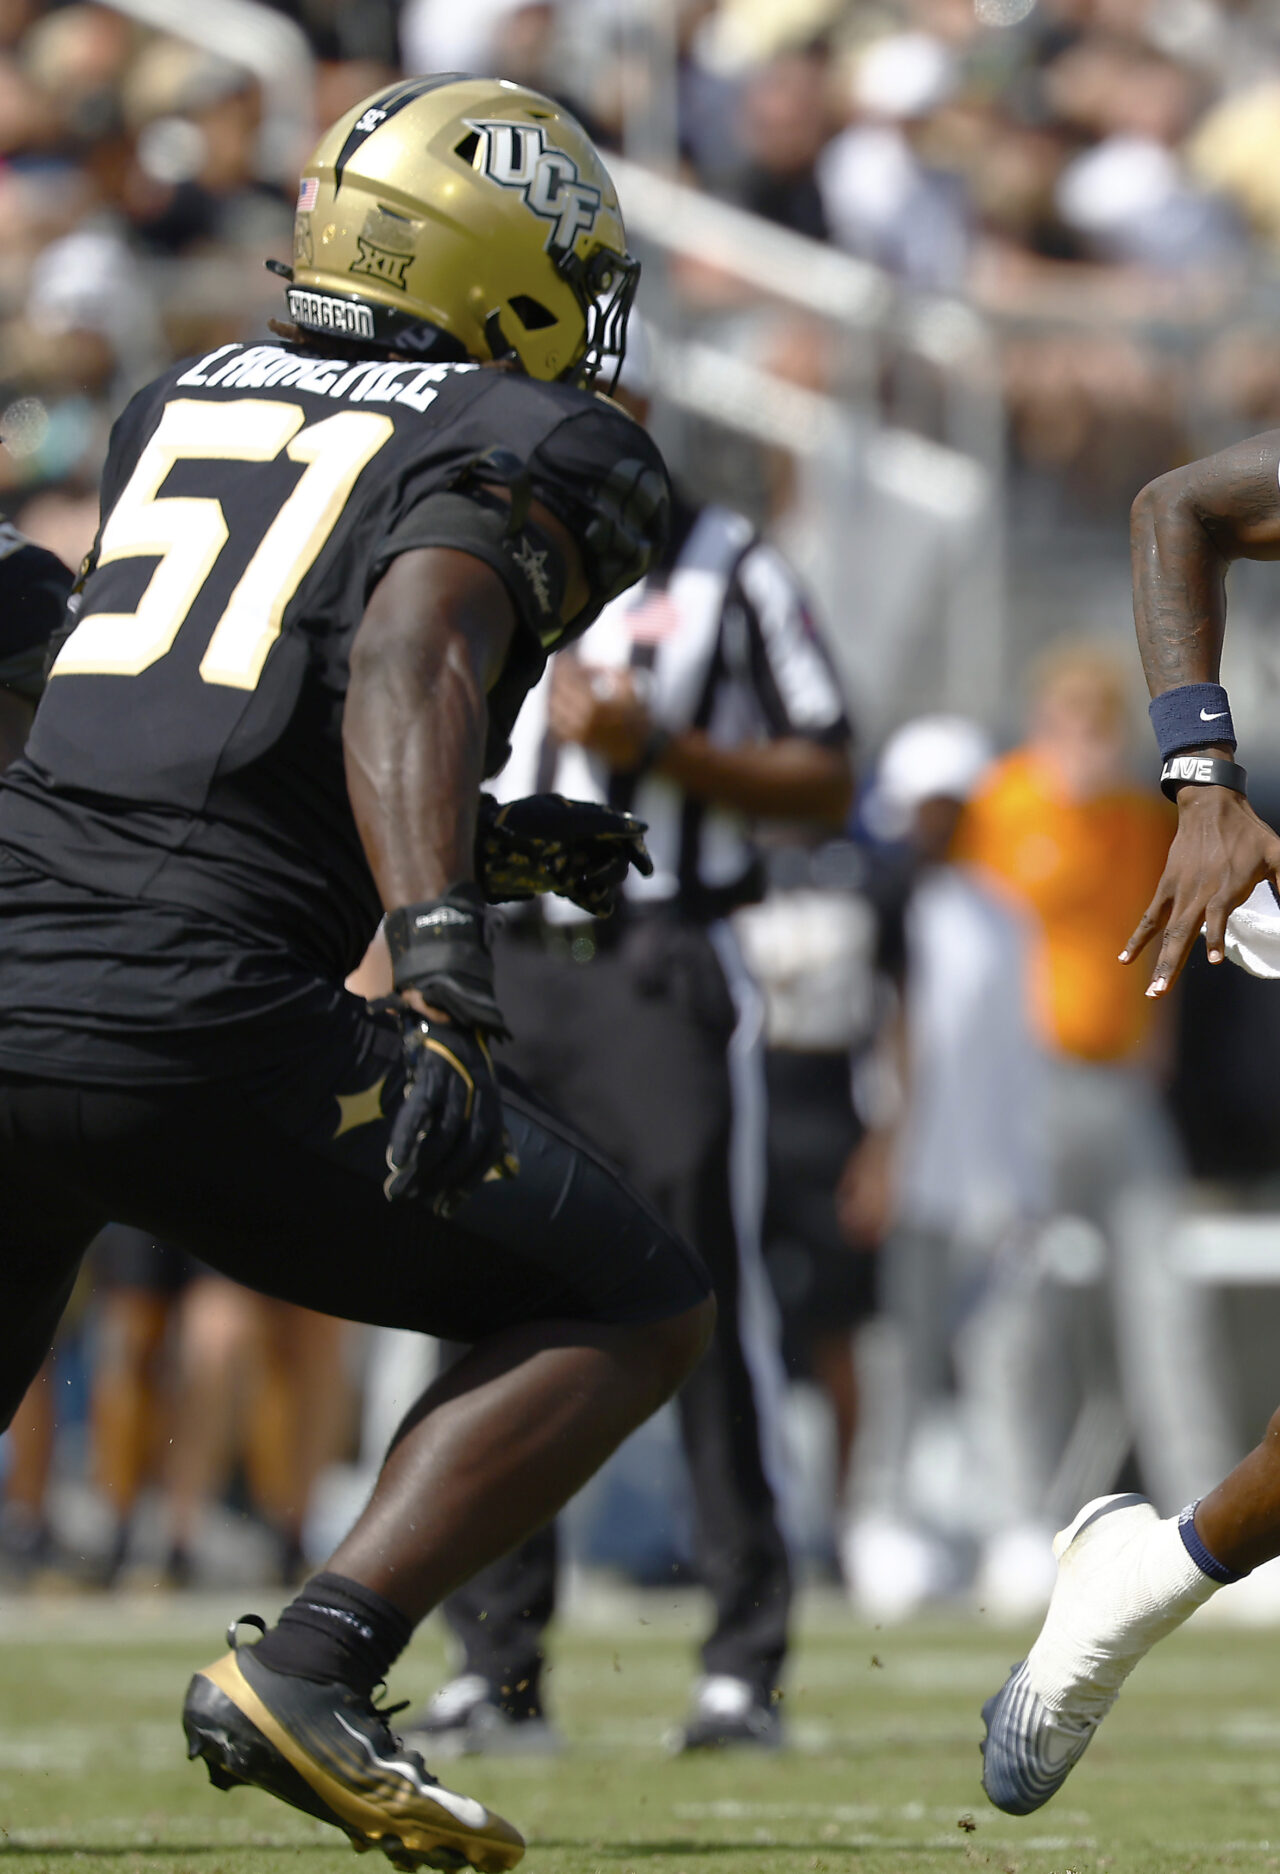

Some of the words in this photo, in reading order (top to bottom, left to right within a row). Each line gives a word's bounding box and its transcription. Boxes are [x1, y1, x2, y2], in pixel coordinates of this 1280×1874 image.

[461, 118, 602, 252] UCF
[348, 236, 416, 291] XII
[48, 398, 395, 691] 51
[1160, 757, 1214, 782] LIVE
